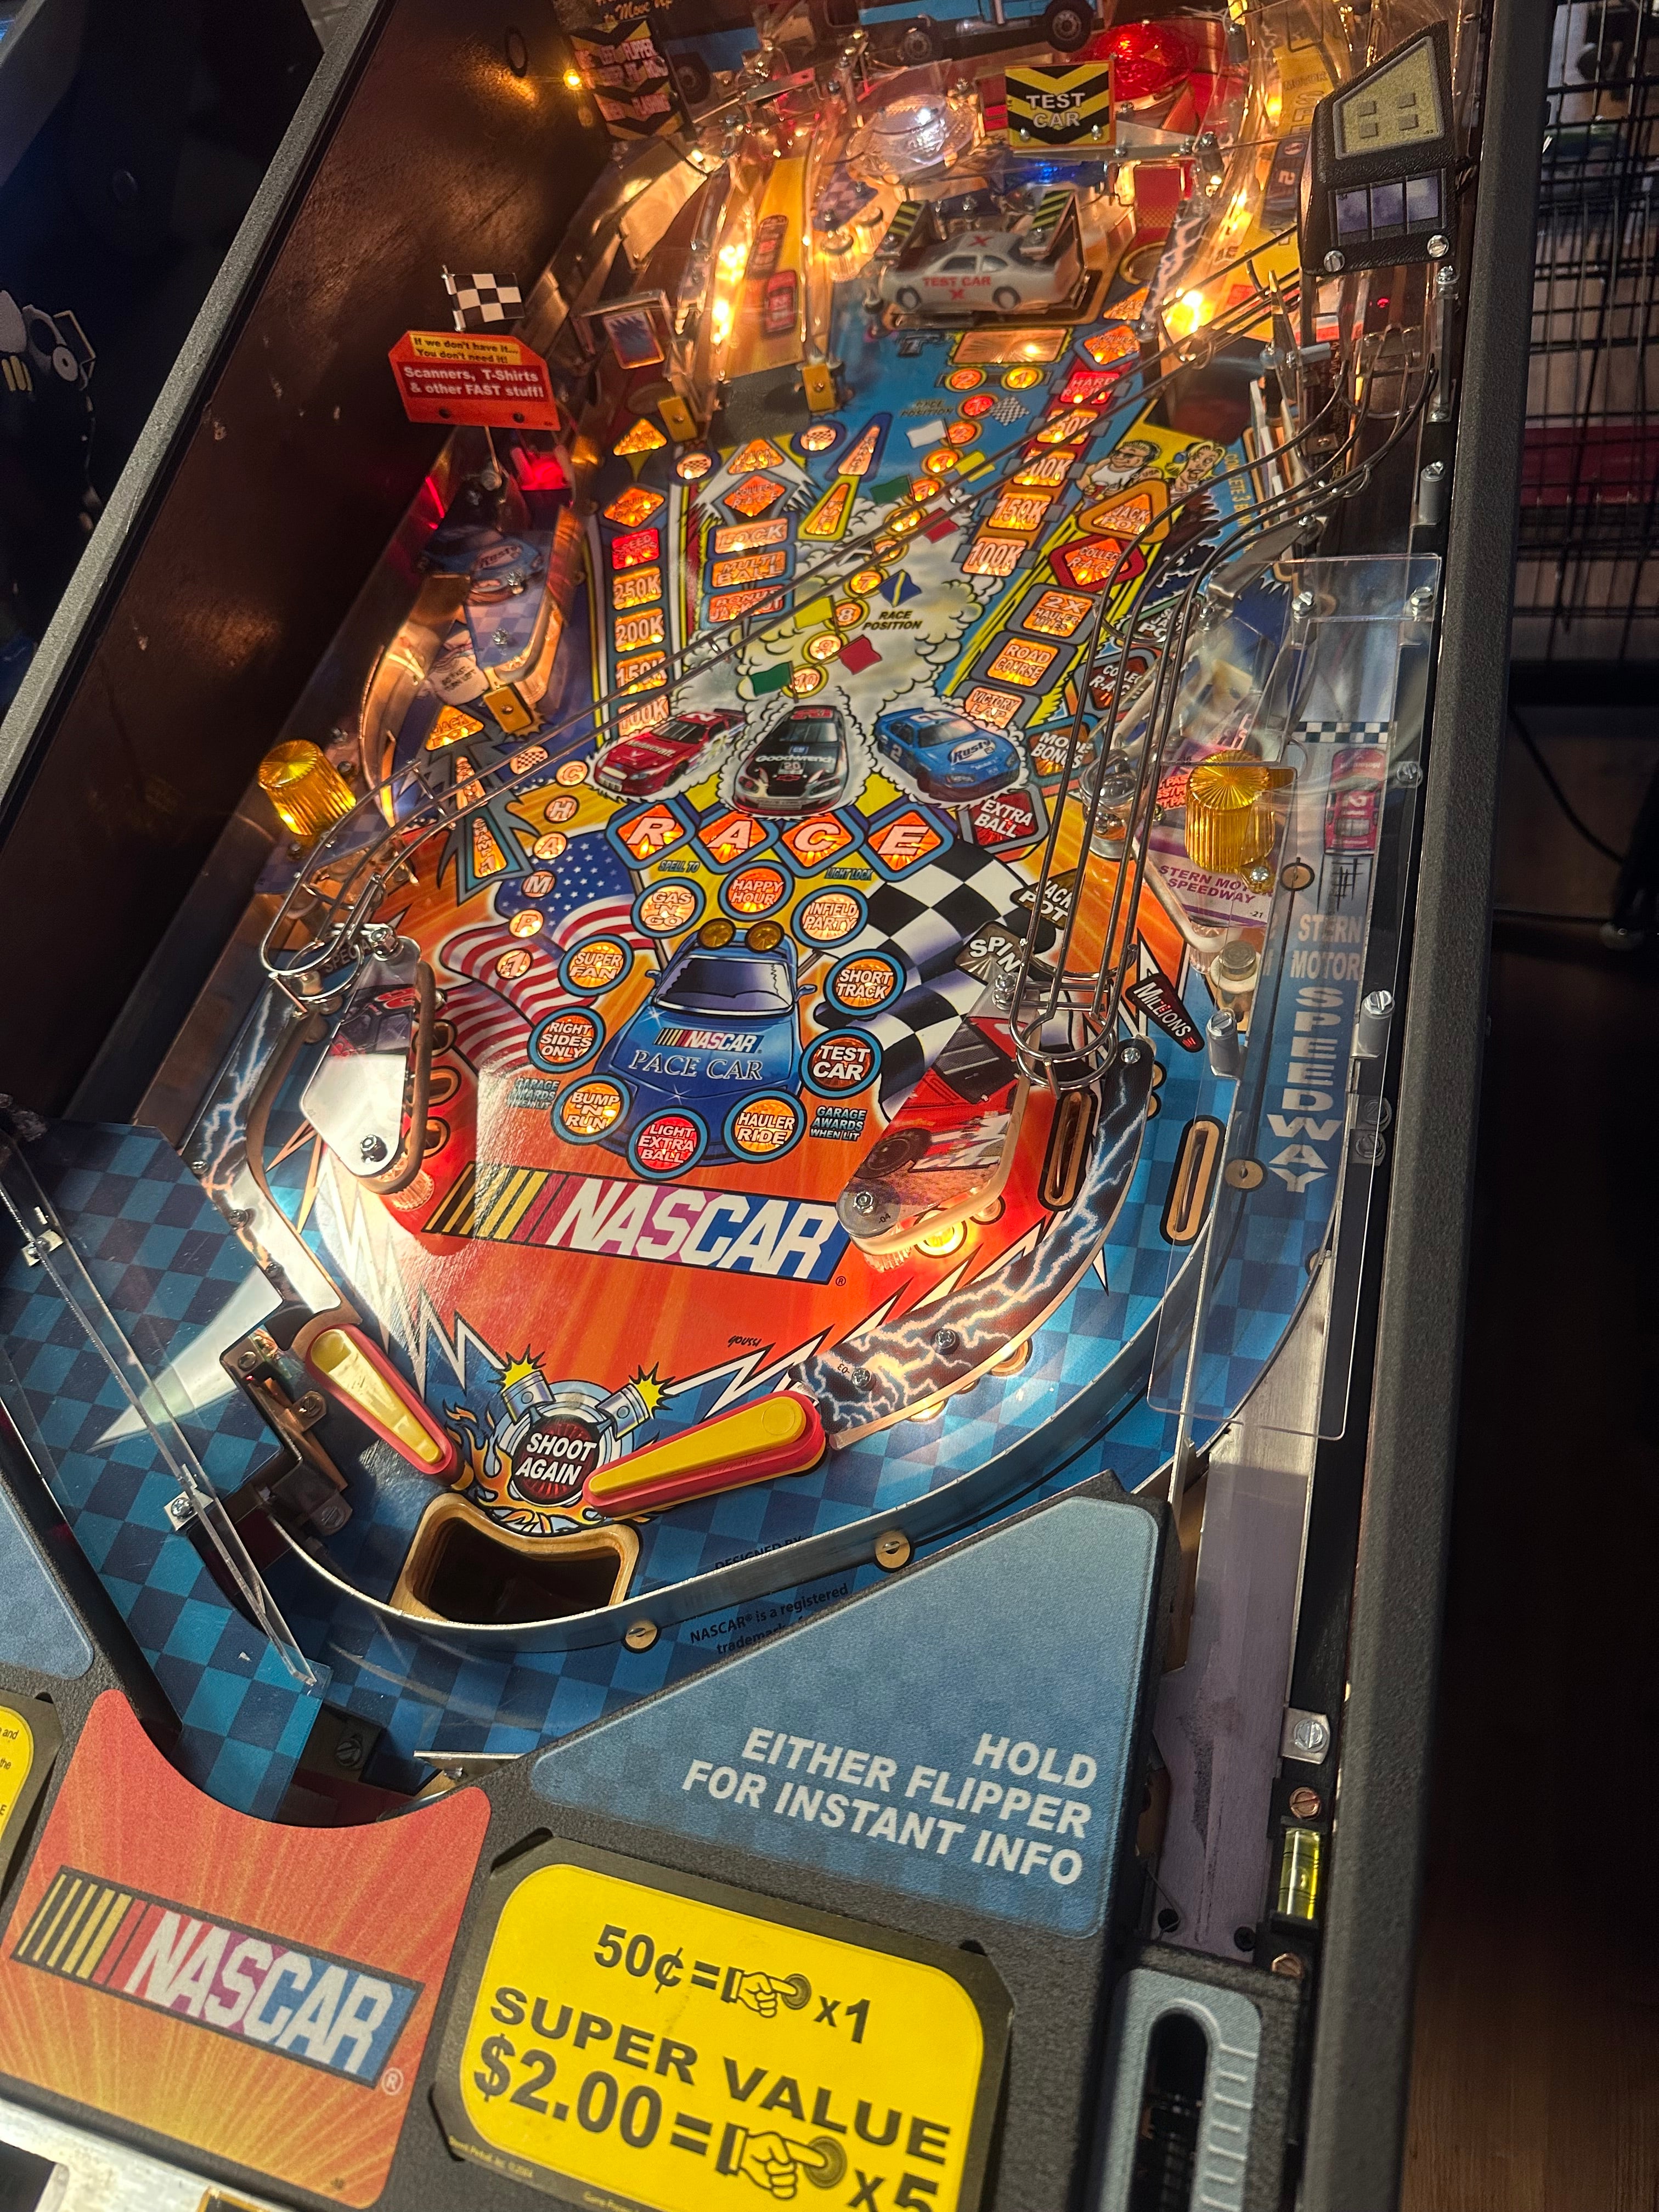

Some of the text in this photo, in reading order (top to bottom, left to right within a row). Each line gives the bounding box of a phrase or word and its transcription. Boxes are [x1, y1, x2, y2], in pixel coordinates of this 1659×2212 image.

[1025, 92, 1086, 109] TEST
[1033, 111, 1080, 128] CAR
[923, 275, 992, 287] TEST CAR
[414, 337, 498, 353] If we don't have
[416, 348, 509, 364] You don't need it!
[403, 366, 540, 383] Scanners, T-Shirts
[1071, 377, 1115, 387] HARD
[410, 382, 545, 398] & other FAST stuff!
[992, 497, 1052, 524] 150K
[1113, 505, 1151, 523] JACK
[721, 524, 784, 548] LOCK
[968, 540, 1027, 570] 100K
[1079, 546, 1124, 561] COLLEC
[721, 553, 778, 573] MULTI
[716, 564, 784, 587] BALL
[859, 576, 874, 589] 7
[613, 573, 662, 598] 250K
[1043, 596, 1086, 614] 2X
[839, 608, 853, 623] 8
[878, 610, 913, 620] RACE
[1031, 607, 1080, 625] HAULER
[616, 614, 664, 645] 200K
[862, 620, 923, 631] POSITION
[1034, 617, 1068, 631] MILES
[1005, 644, 1052, 664] ROAD
[995, 658, 1046, 681] COURSE
[794, 673, 819, 689] 10
[972, 690, 1018, 711] VICTORY
[970, 704, 1007, 720] LAP
[755, 754, 836, 764] Goodwrench
[890, 744, 903, 763] 2
[951, 738, 992, 765] Rusty
[981, 799, 1033, 827] EXTRA
[974, 815, 1018, 839] BALL
[473, 819, 493, 859] CHAMP
[627, 816, 930, 857] R A C E
[500, 765, 585, 978] C H A M P #1
[658, 860, 701, 873] SPELL TO
[824, 867, 874, 881] LIGHT LOCK
[731, 879, 785, 893] HAPPY
[1159, 865, 1274, 898] STERN MOTR
[652, 891, 693, 905] GAS
[731, 890, 776, 905] HOUR
[1166, 878, 1257, 904] SPEEDWAY
[658, 904, 678, 915] 'N
[809, 902, 857, 917] INFIELD
[645, 915, 684, 927] GO
[803, 915, 857, 932] PARTY
[1297, 913, 1361, 943] STERN
[575, 952, 623, 967] SUPER
[969, 935, 1022, 973] SPIN
[569, 966, 618, 980] FAN
[1290, 951, 1361, 981] MOTOR
[838, 968, 894, 985] SHORT
[836, 983, 889, 1000] TRACK
[1133, 981, 1192, 1038] MILLIONS
[549, 1022, 593, 1035] RIGHT
[540, 1034, 594, 1048] SIDES
[684, 1029, 757, 1053] NASCAR
[541, 1046, 584, 1059] ONLY
[819, 1045, 871, 1063] TEST
[628, 1049, 764, 1081] PACE CAR
[812, 1062, 864, 1081] CAR
[515, 1077, 560, 1090] GARAGE
[1266, 986, 1344, 1194] SPEEDWAY
[533, 1101, 552, 1110] LIT
[571, 1091, 620, 1107] BUMP
[575, 1104, 604, 1116] 'N
[816, 1105, 867, 1120] GARAGE
[565, 1115, 608, 1130] RUN
[737, 1112, 795, 1131] HAULER
[811, 1117, 864, 1131] AWARDS
[649, 1124, 696, 1138] LIGHT
[737, 1127, 788, 1146] RIDE
[809, 1128, 861, 1141] WHEN LIT
[638, 1135, 695, 1153] EXTRA
[641, 1149, 684, 1164] BALL
[878, 1212, 892, 1224] -04
[544, 1178, 836, 1280] NASCAR
[526, 1432, 598, 1462] SHOOT
[515, 1456, 583, 1486] AGAIN
[756, 1611, 767, 1624] is
[769, 1608, 778, 1618] a
[780, 1583, 850, 1615] registered
[2, 1728, 20, 1741] and
[971, 1733, 1098, 1790] HOLD
[741, 1726, 1093, 1839] EITHER FLIPPER
[681, 1758, 1084, 1886] FOR INSTANT INFO
[123, 1910, 394, 2073] NASCAR
[813, 1997, 872, 2044] x1
[490, 1985, 951, 2167] SUPER VALUE
